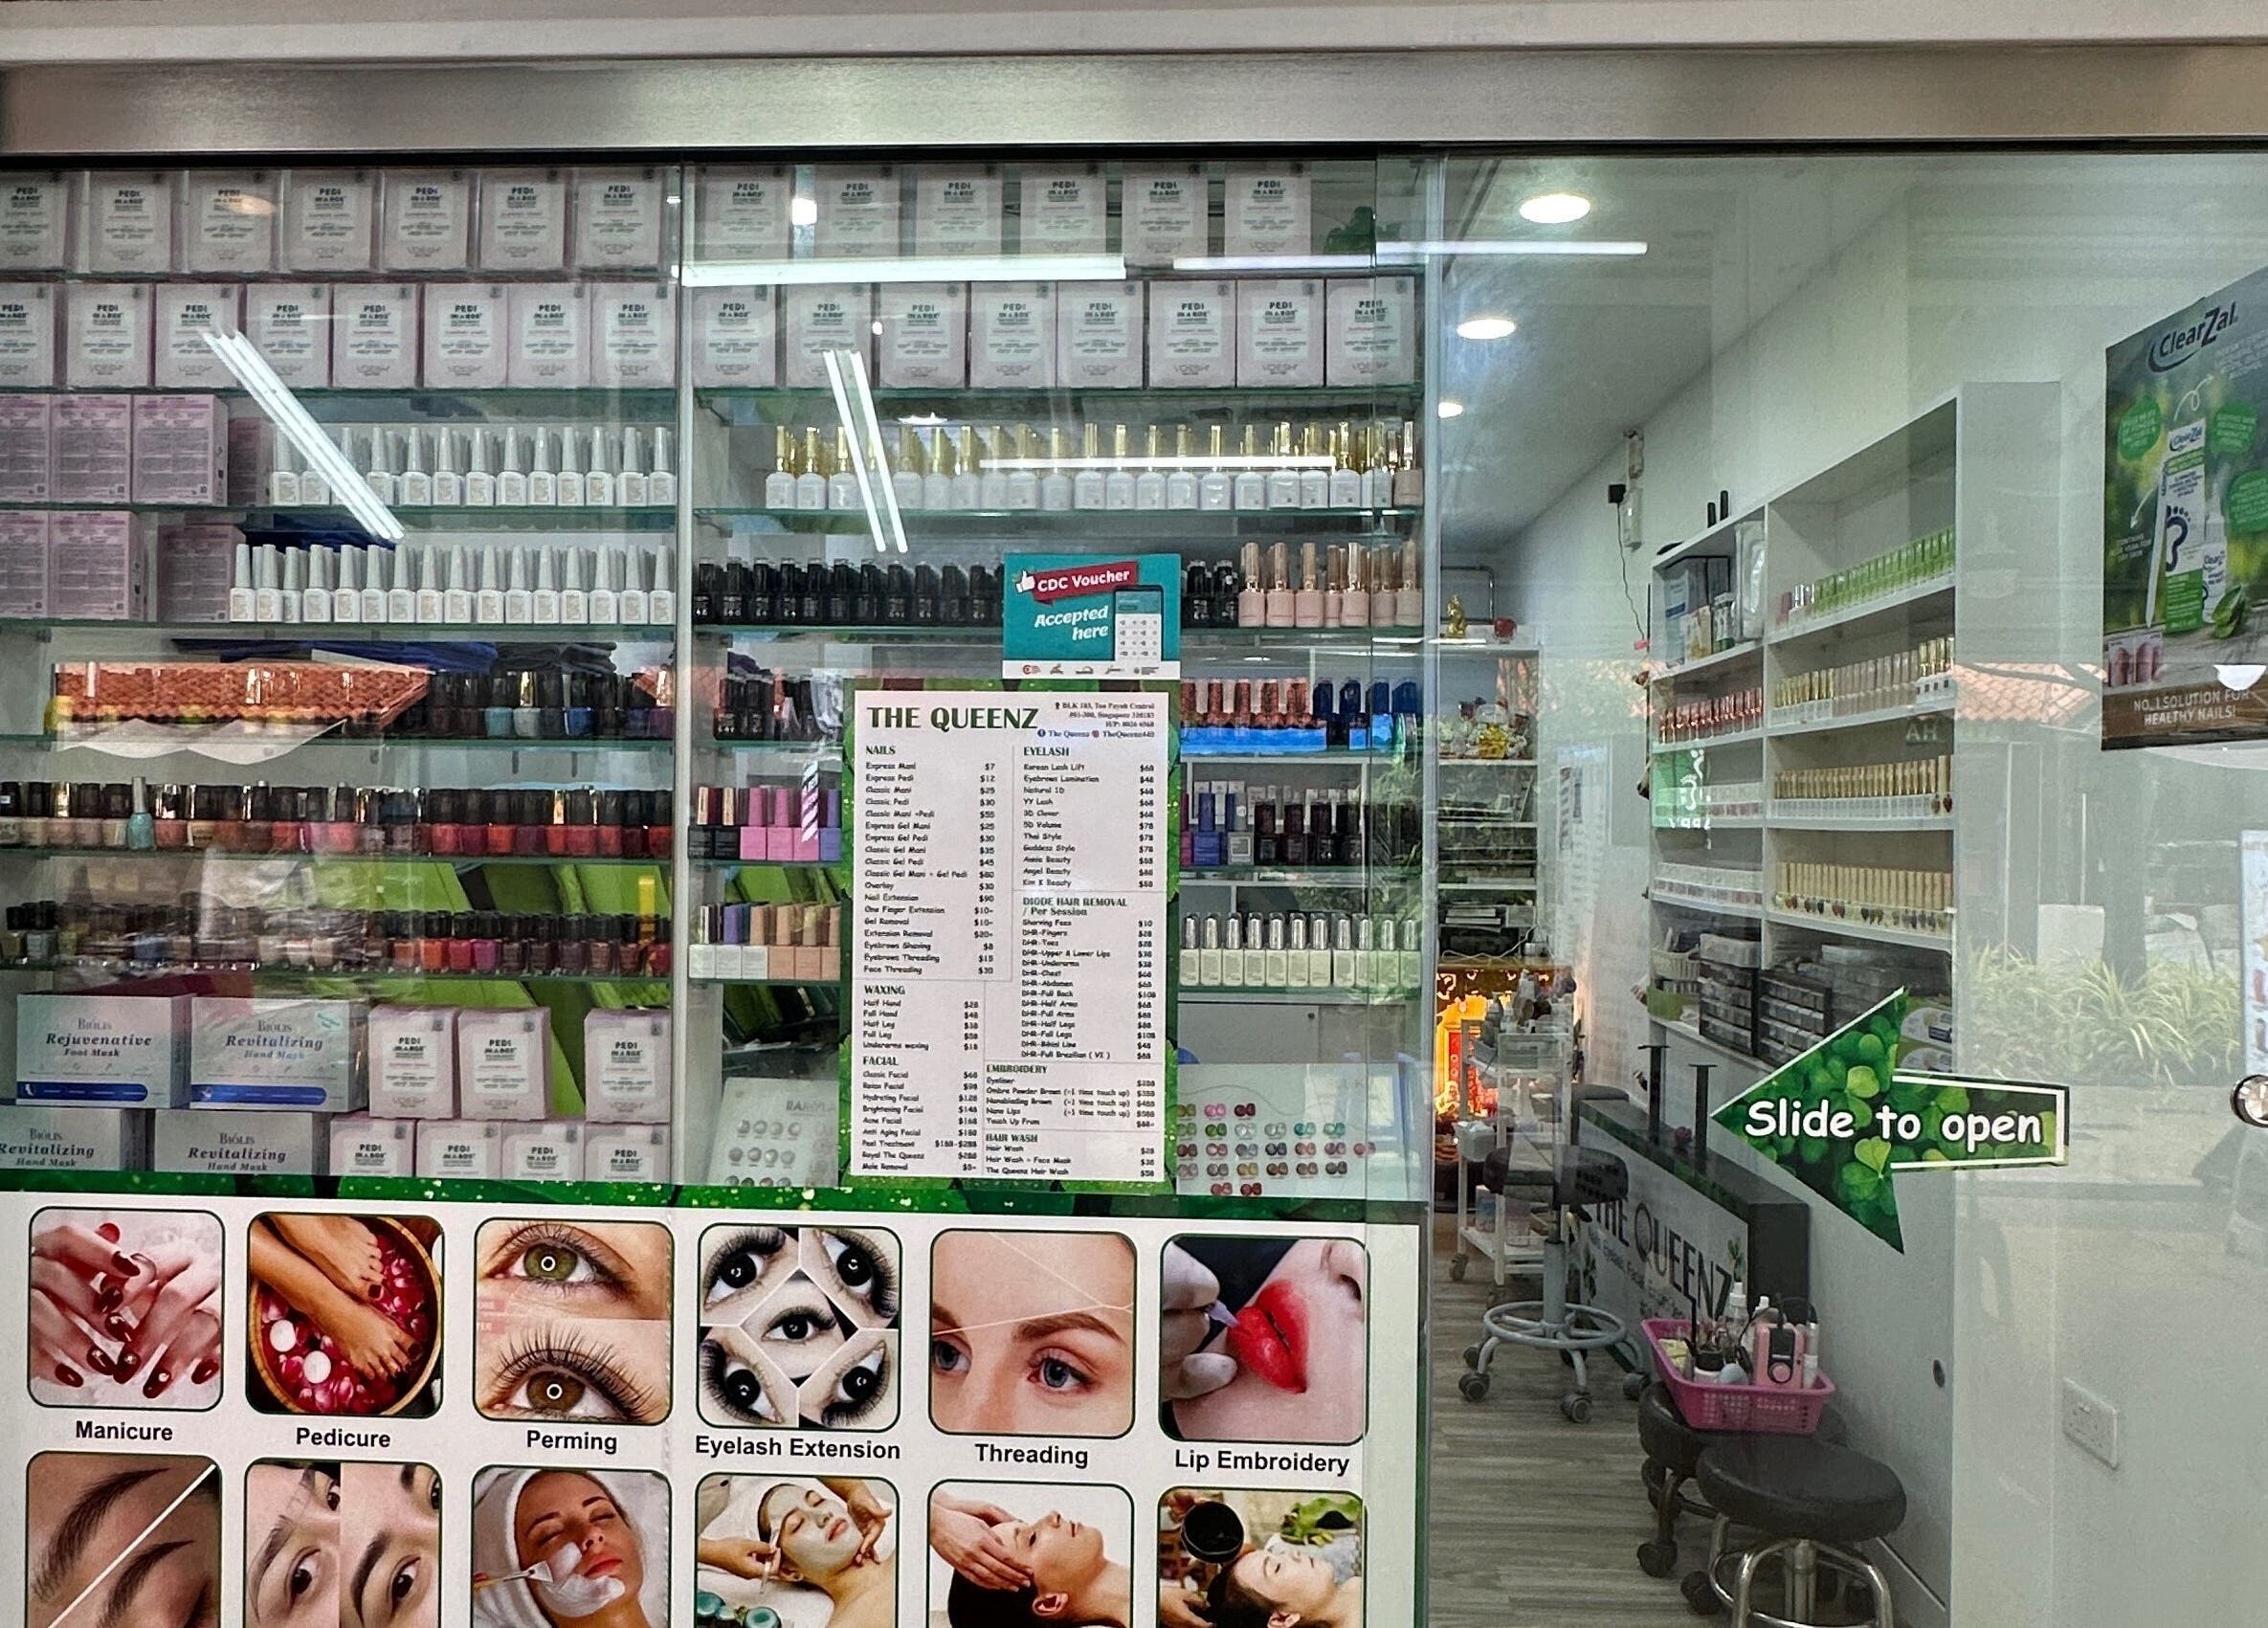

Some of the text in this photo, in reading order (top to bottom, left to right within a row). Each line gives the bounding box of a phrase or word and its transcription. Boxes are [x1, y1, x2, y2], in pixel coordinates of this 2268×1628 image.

[2160, 301, 2236, 357] ClearZal
[1037, 570, 1129, 591] CDC Voucher
[1034, 605, 1108, 628] Accepted
[1072, 626, 1108, 640] here
[867, 707, 1038, 732] THE QUEENZ
[2144, 705, 2235, 725] HEALTHY NAILS!
[866, 746, 896, 754] NAILS
[1024, 747, 1069, 756] EYELASH
[1083, 898, 1128, 906] REMOVAL
[864, 985, 905, 994] WAXING
[46, 1033, 152, 1047] Rejuvenative
[227, 1035, 323, 1050] Revitalizing
[863, 1057, 899, 1065] FACIAL
[1745, 1099, 2040, 1152] Slide to open
[188, 1148, 286, 1163] Revitalizing
[208, 1162, 236, 1171] Hand
[76, 1420, 173, 1442] Manicure
[296, 1427, 391, 1449] Pedicure
[525, 1430, 618, 1454] Perming
[695, 1436, 901, 1460] Eyelash Extension
[974, 1443, 1089, 1469] Threading
[1174, 1448, 1349, 1477] Lip Embroidery
